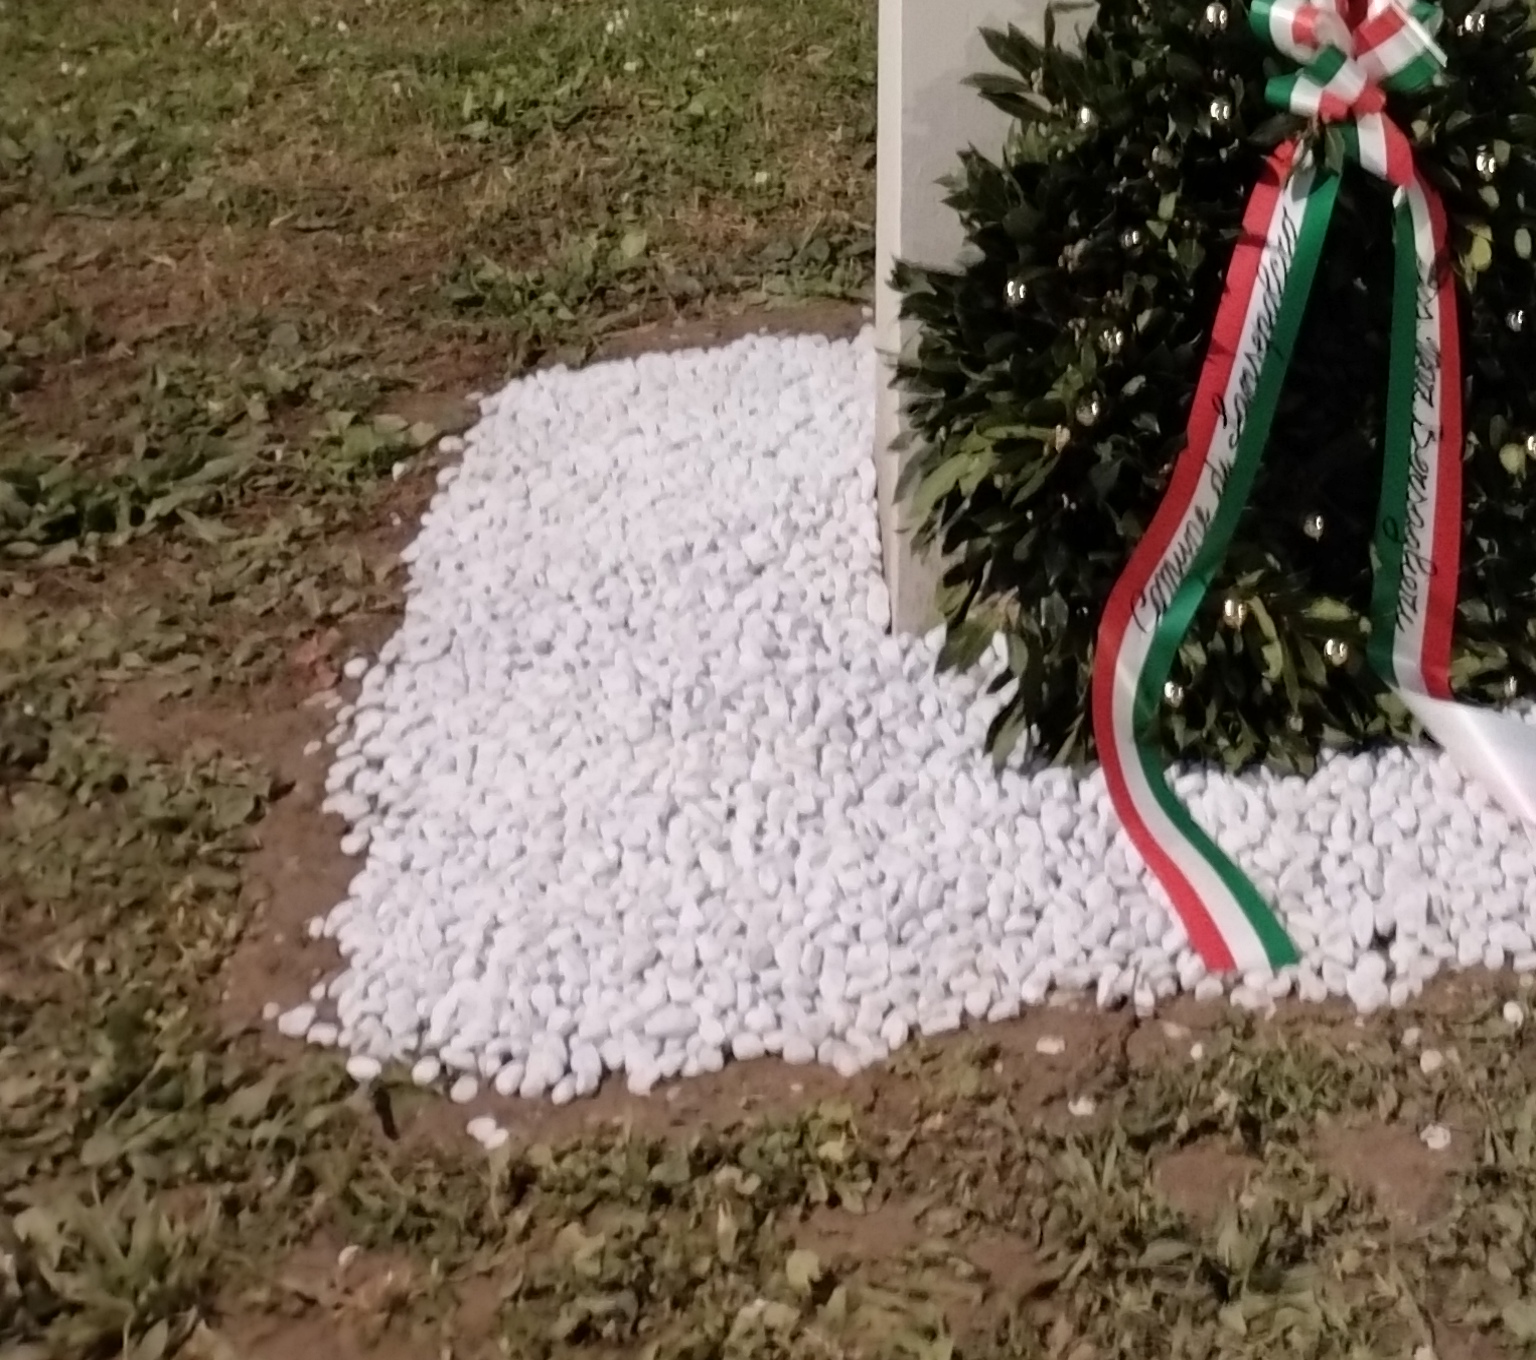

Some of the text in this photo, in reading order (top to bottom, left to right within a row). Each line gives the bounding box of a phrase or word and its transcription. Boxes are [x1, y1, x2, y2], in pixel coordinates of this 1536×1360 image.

[1130, 505, 1210, 634] Comune
[1203, 455, 1232, 500] di
[1382, 416, 1443, 633] Bersaglieri
